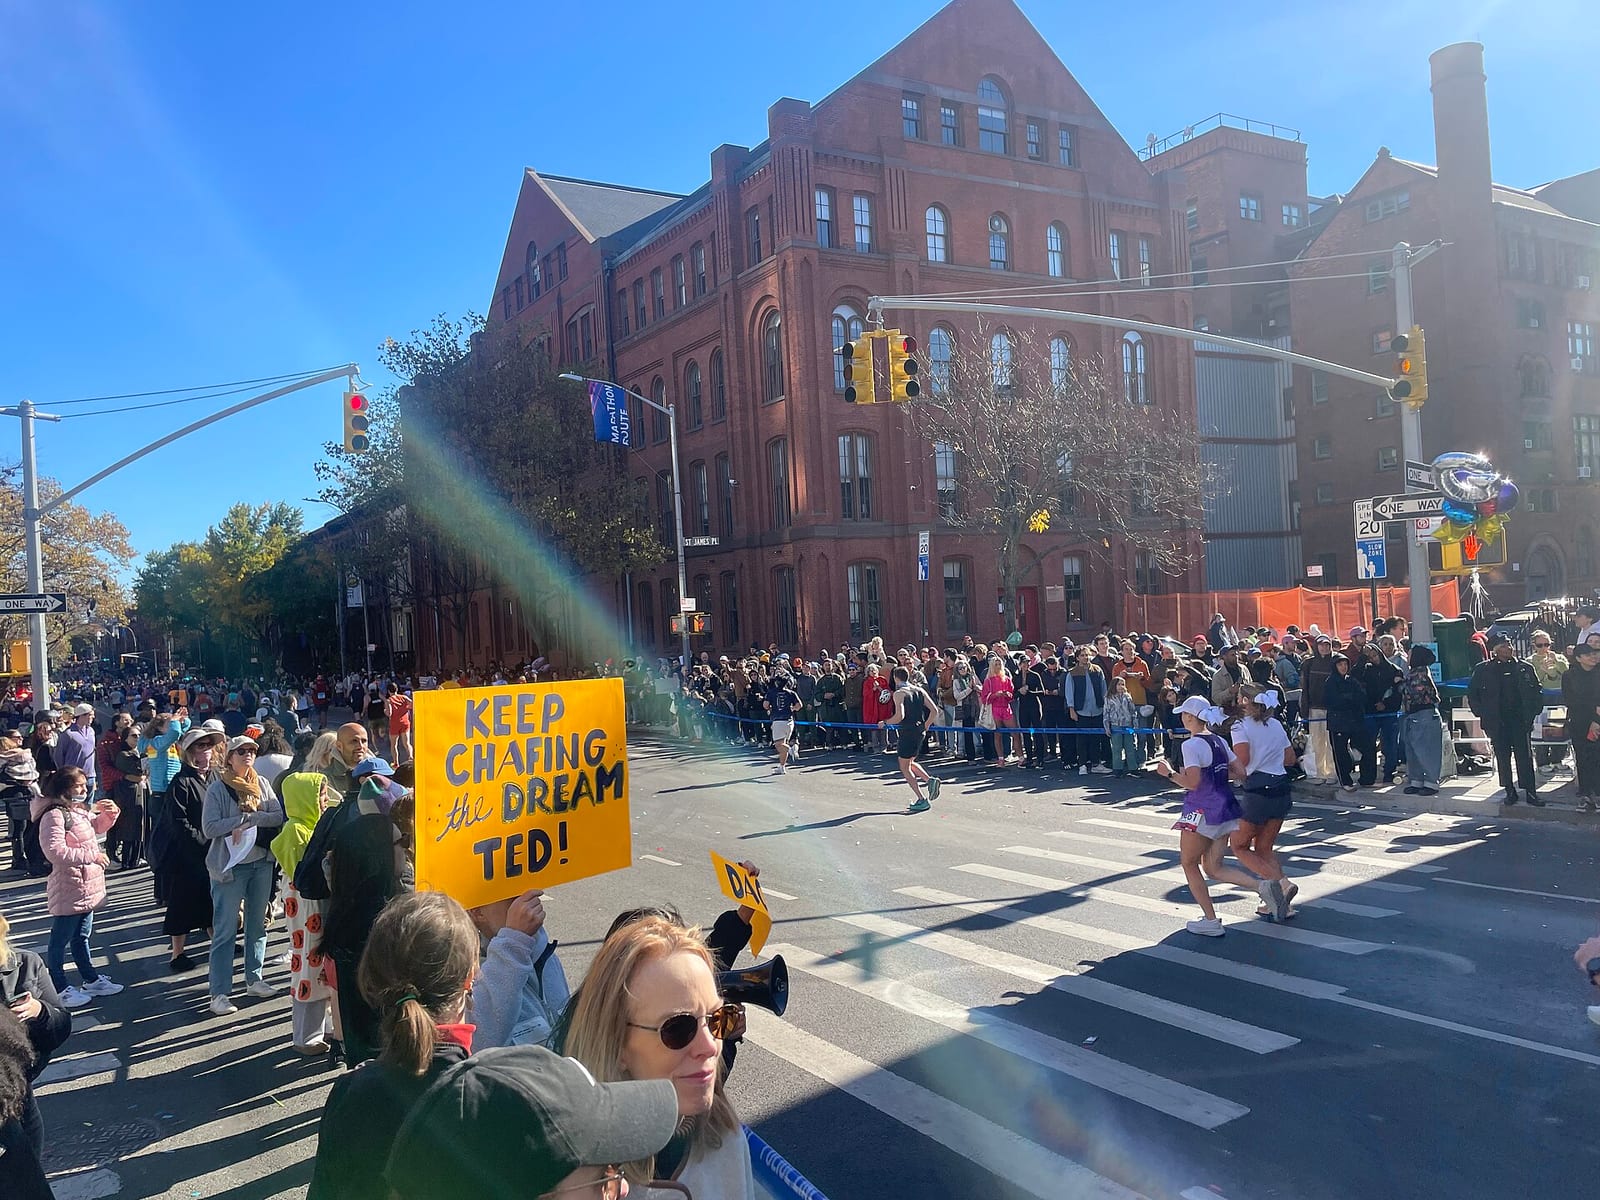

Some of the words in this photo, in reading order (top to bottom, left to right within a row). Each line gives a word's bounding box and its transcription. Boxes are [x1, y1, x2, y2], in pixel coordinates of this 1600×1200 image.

[1408, 469, 1422, 480] ONE
[1357, 503, 1373, 511] SPE
[1380, 503, 1404, 514] ONE
[1417, 500, 1441, 510] WAY
[1359, 511, 1372, 519] LIM
[1360, 520, 1380, 534] 20
[5, 600, 25, 609] ONE
[34, 599, 56, 608] WAY
[465, 693, 565, 740] KEEP
[445, 729, 608, 787] CHAFING
[435, 792, 494, 842] the
[501, 760, 624, 825] DREAM
[472, 821, 569, 881] TED!
